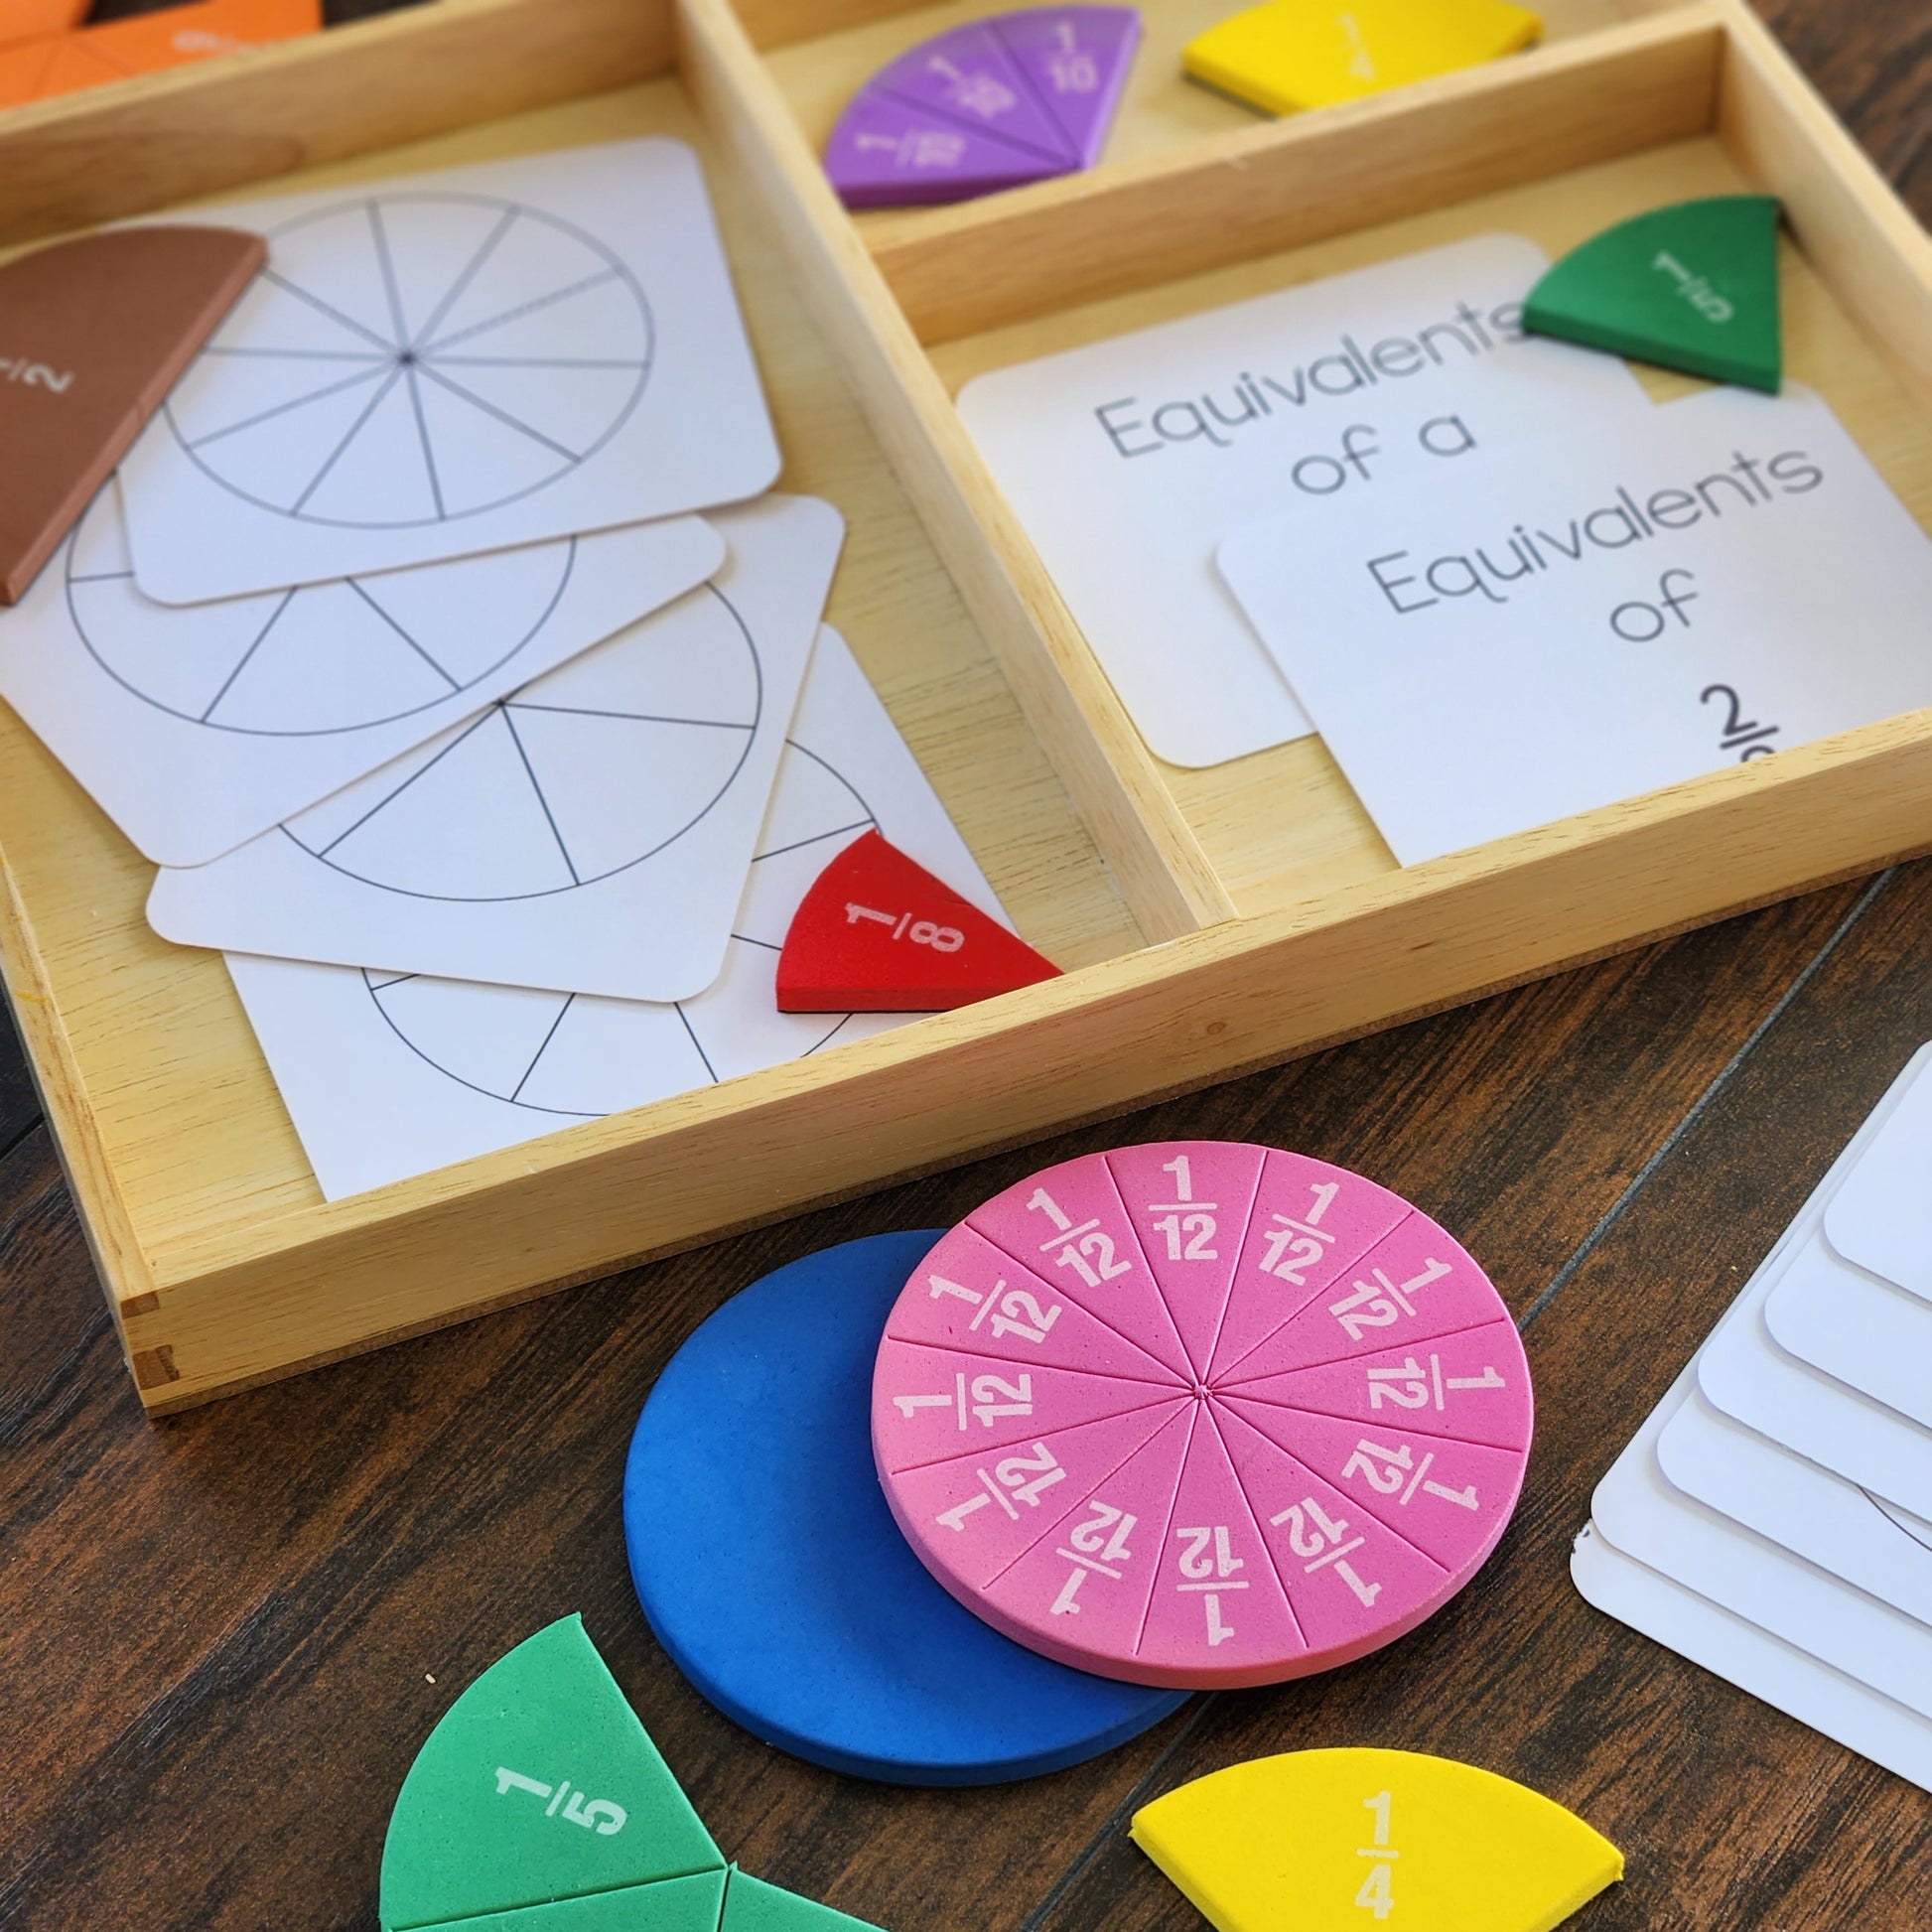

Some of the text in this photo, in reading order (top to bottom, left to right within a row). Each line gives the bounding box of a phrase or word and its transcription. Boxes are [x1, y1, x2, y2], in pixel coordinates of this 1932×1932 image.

[24, 362, 74, 393] 2
[1094, 301, 1527, 459] Equivalents
[1291, 413, 1478, 495] of a
[1366, 450, 1825, 615] Equivalents
[1609, 568, 1700, 643] of
[1700, 683, 1758, 737] 2
[844, 901, 897, 926] 1
[908, 920, 966, 954] 8
[1163, 1155, 1192, 1202] 1
[1305, 1181, 1339, 1225] 1
[1026, 1187, 1072, 1231] 1
[1055, 1232, 1133, 1288] 12
[1153, 1213, 1218, 1261] 12
[1258, 1229, 1323, 1287] 12
[927, 1274, 983, 1305] 1
[1400, 1257, 1452, 1295] 1
[990, 1290, 1062, 1343] 12
[1328, 1280, 1399, 1341] 12
[970, 1373, 1034, 1428] 12
[1367, 1357, 1430, 1410] 12
[1446, 1366, 1506, 1390] 1
[892, 1394, 953, 1419] 1
[995, 1442, 1067, 1507] 12
[1341, 1439, 1414, 1494] 12
[935, 1492, 992, 1532] 1
[1423, 1479, 1479, 1511] 1
[1070, 1499, 1138, 1562] 12
[1175, 1525, 1244, 1580] 12
[1270, 1496, 1349, 1558] 12
[1049, 1567, 1087, 1616] 1
[1333, 1560, 1382, 1607] 1
[1204, 1593, 1235, 1646] 1
[495, 1766, 553, 1798] 1
[562, 1791, 627, 1836] 5
[1363, 1790, 1392, 1846] 1
[1355, 1863, 1395, 1919] 4
